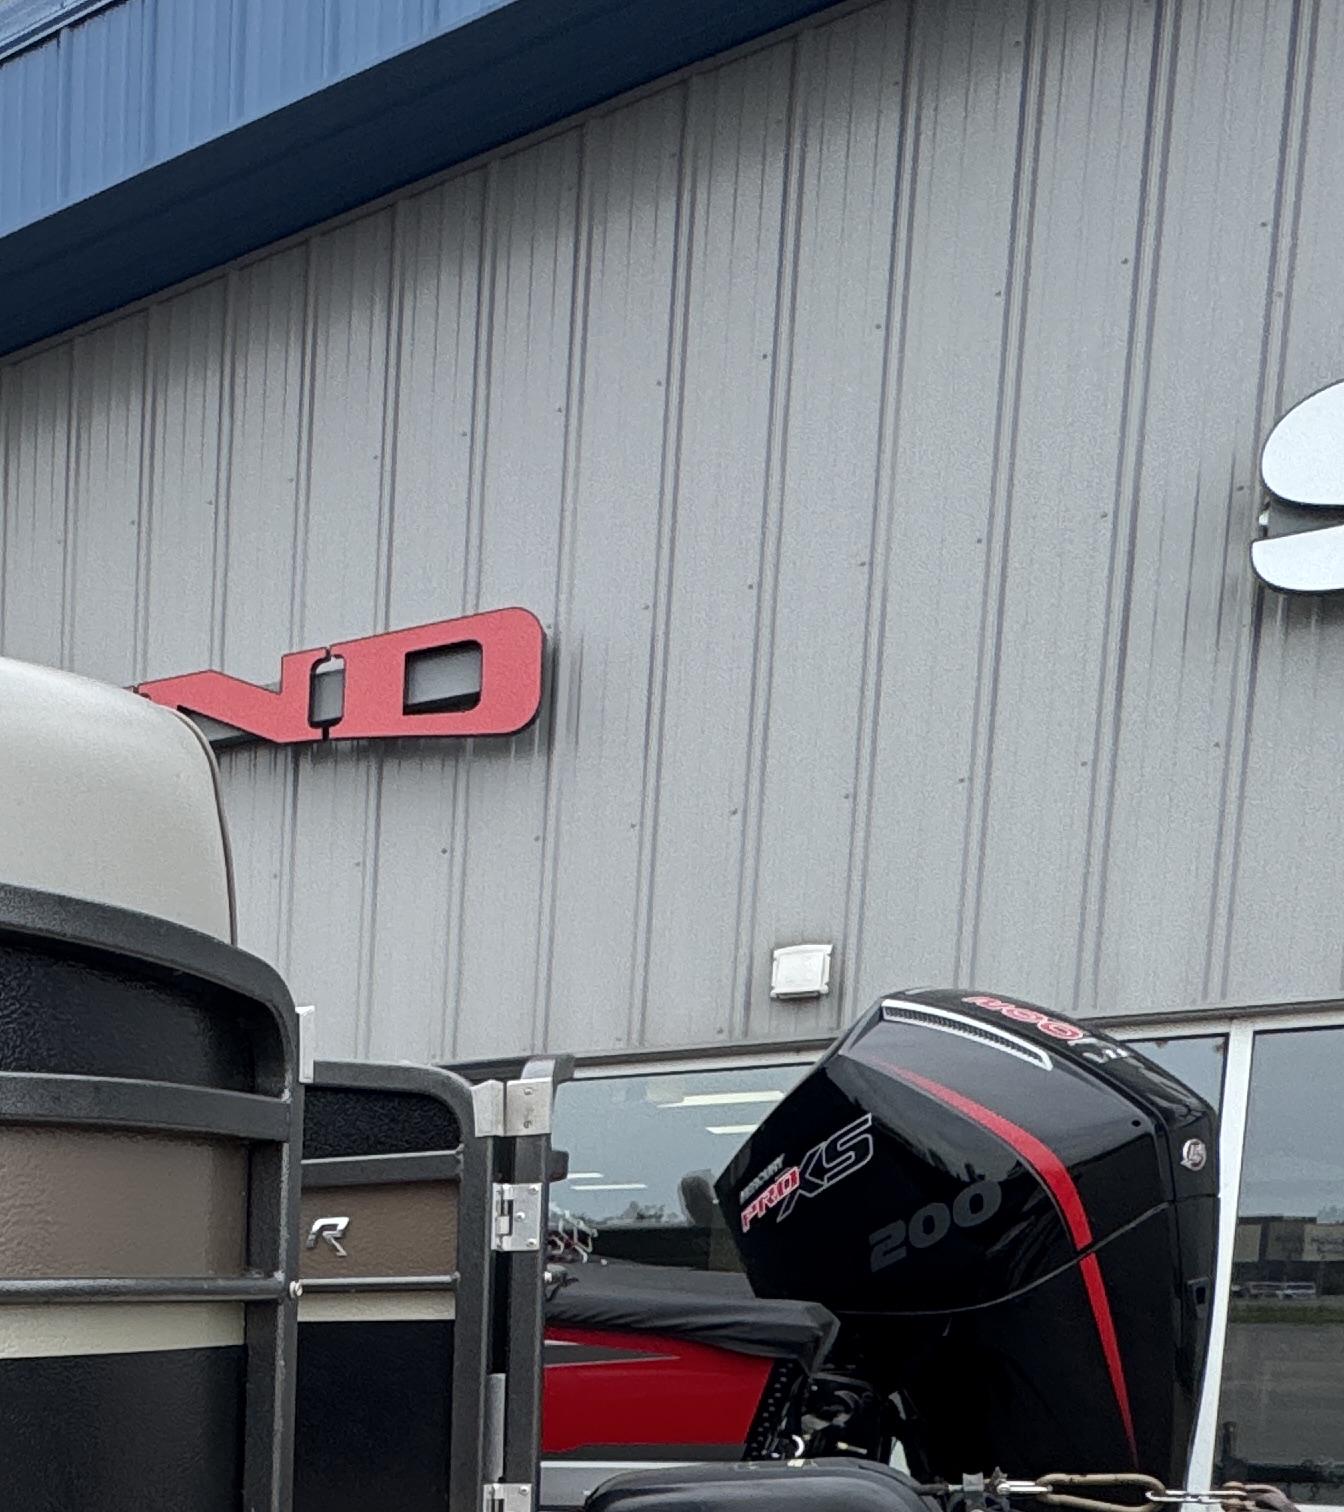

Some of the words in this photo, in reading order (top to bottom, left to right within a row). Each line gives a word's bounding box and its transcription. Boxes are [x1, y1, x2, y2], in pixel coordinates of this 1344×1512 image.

[121, 607, 544, 744] ND
[741, 1166, 800, 1233] PRO
[776, 1112, 874, 1223] XS
[868, 1180, 1002, 1273] 200
